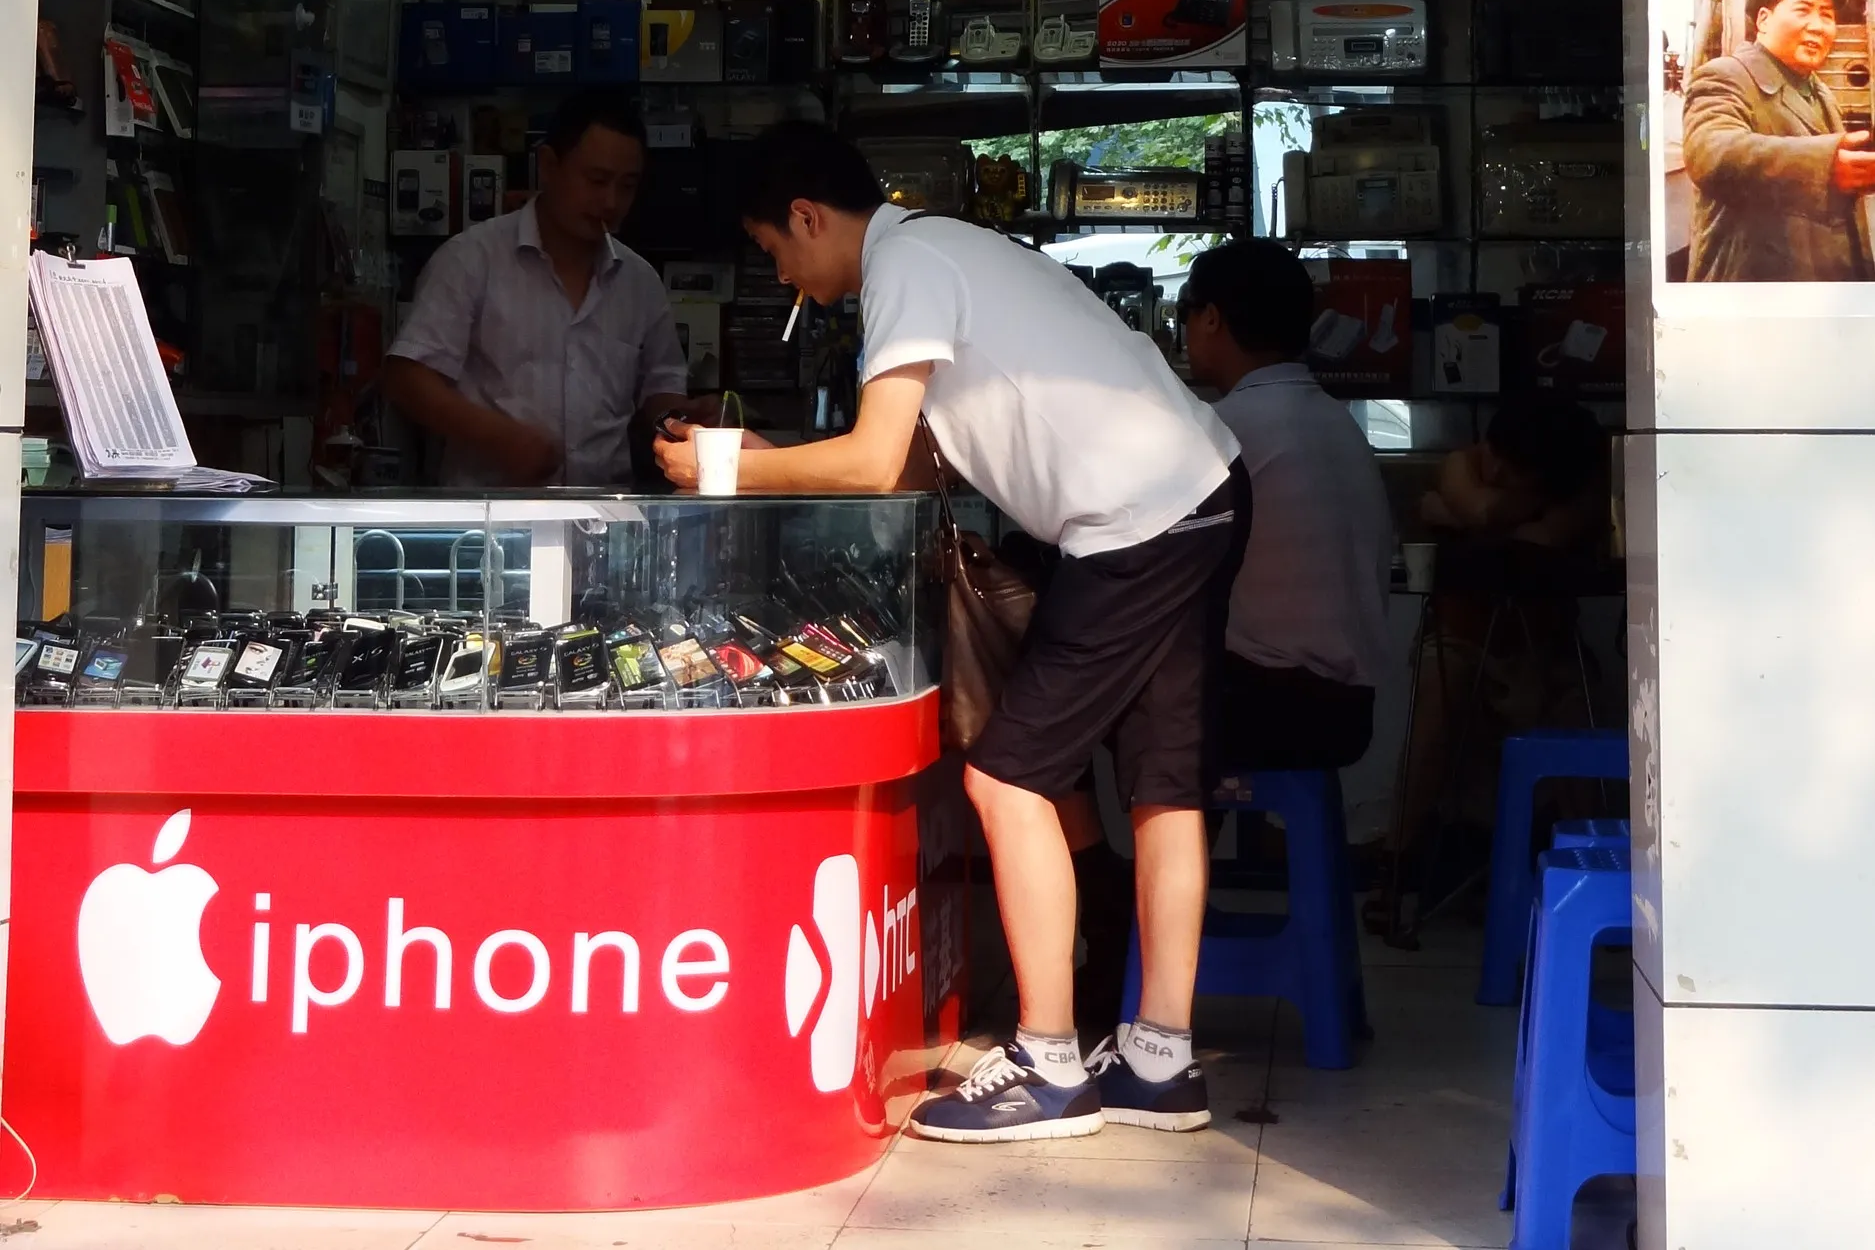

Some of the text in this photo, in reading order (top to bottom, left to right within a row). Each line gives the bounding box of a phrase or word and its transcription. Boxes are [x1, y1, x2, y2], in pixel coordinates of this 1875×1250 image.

[251, 893, 730, 1034] iphone
[1044, 1050, 1077, 1064] CBA
[1133, 1037, 1175, 1059] CBA
